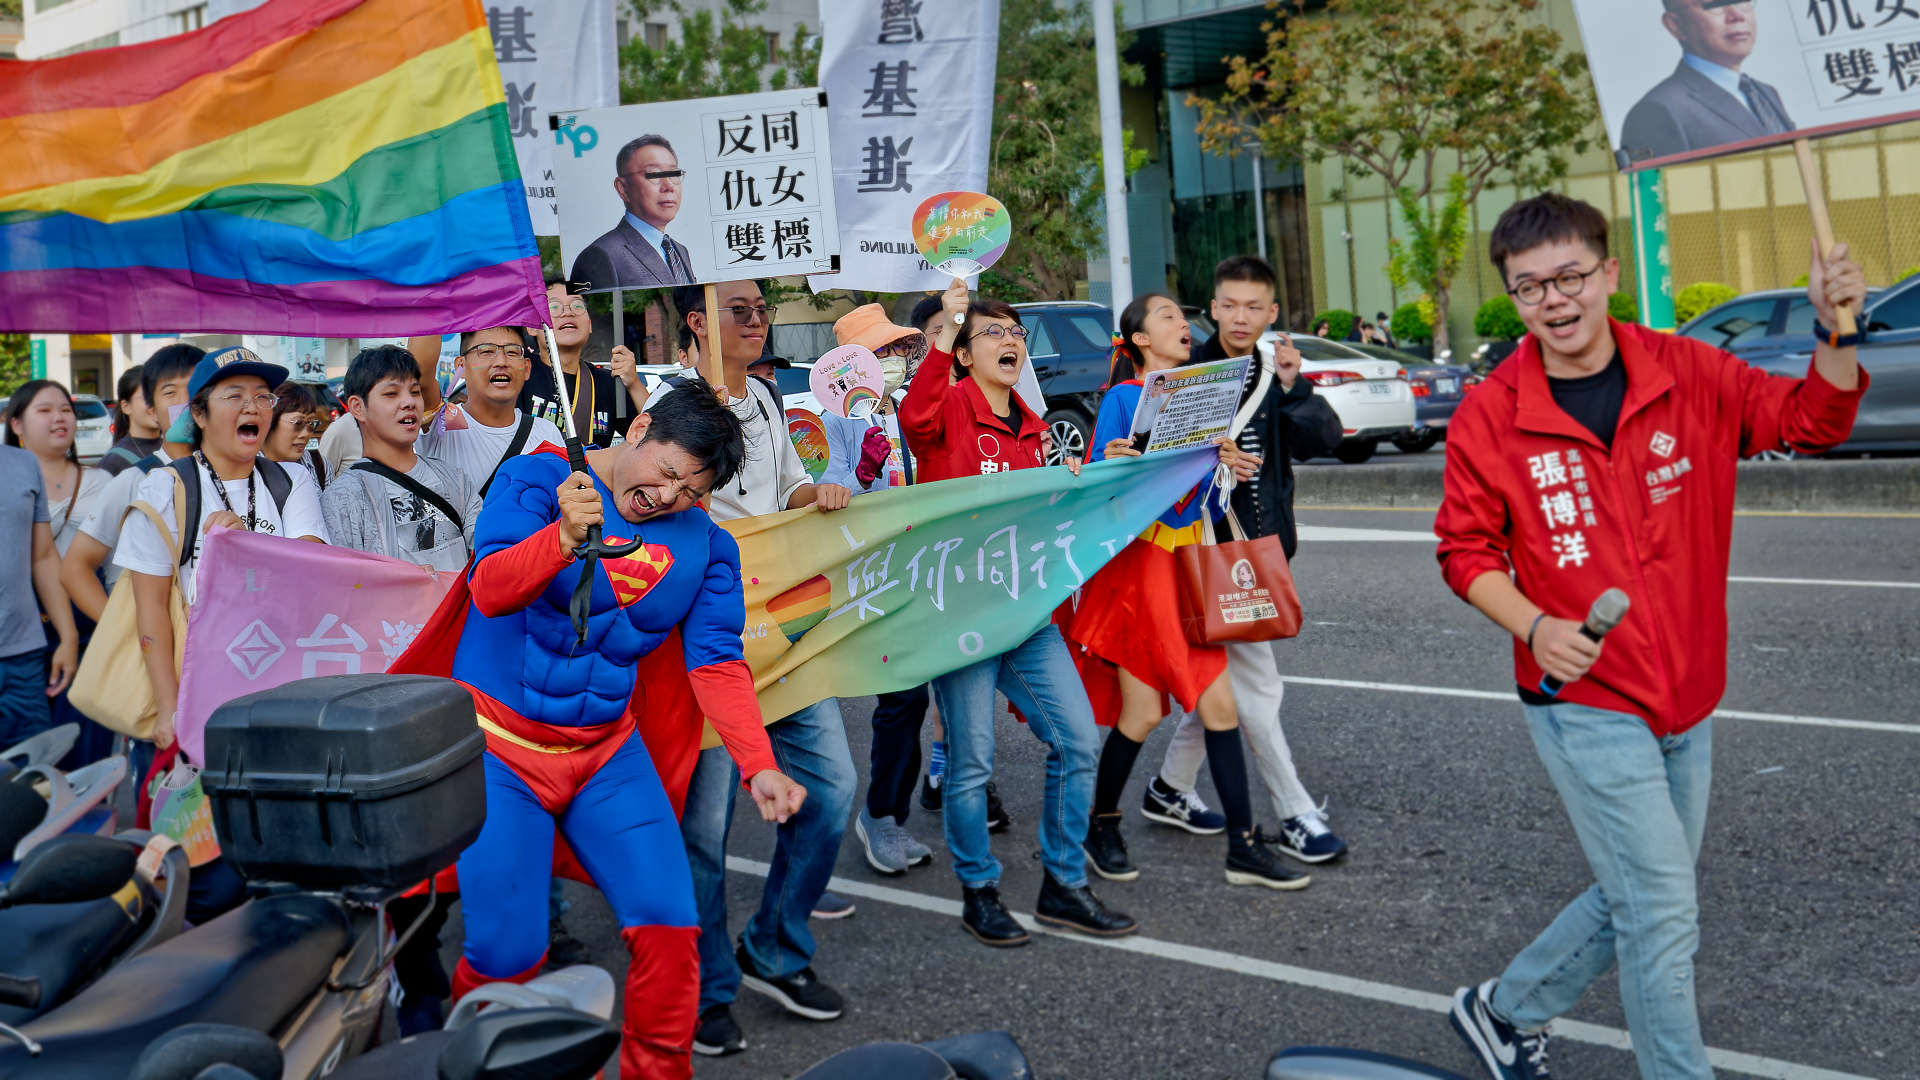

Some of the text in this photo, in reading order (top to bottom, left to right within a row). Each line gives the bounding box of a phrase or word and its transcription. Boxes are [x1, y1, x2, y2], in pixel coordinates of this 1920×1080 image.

[717, 110, 799, 158] 反同
[719, 165, 806, 211] 仇女
[724, 216, 813, 265] 雙標
[1527, 451, 1591, 569] 張博洋
